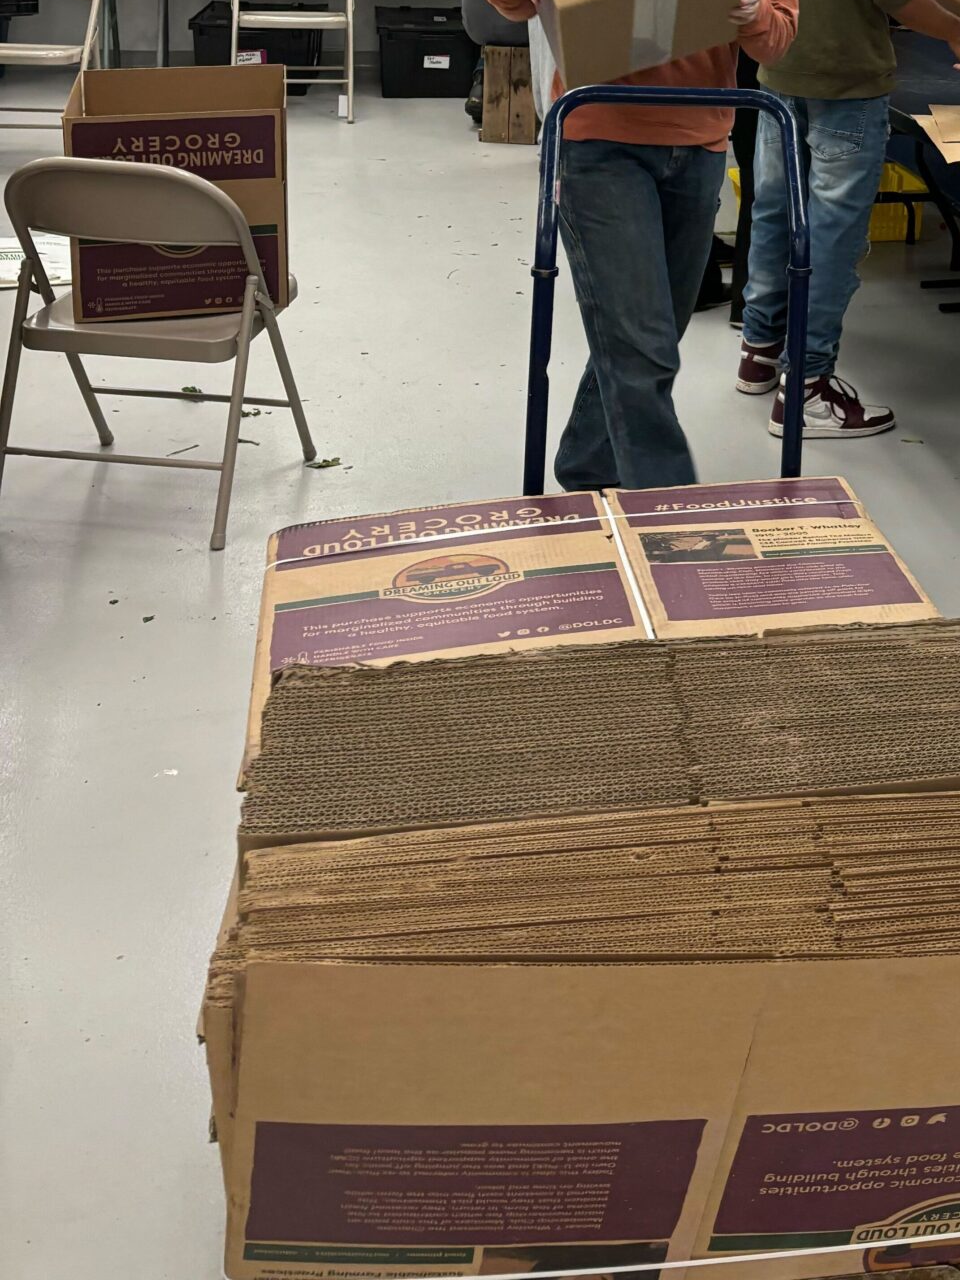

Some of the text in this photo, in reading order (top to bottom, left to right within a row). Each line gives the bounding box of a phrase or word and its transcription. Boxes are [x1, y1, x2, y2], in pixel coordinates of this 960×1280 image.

[112, 132, 241, 153] GROCERY
[178, 148, 263, 167] DREAMING
[654, 495, 818, 512] #FoodJustice
[342, 507, 543, 541] GROCERY
[303, 538, 376, 557] LOUD
[383, 571, 521, 596] DREAMING OUT LOUD
[423, 585, 483, 596] GROCERY
[302, 594, 604, 638] for marginalized communities through building
[303, 588, 603, 632] This purchase supports economic opportunities
[360, 606, 564, 636] healthy, equitable food system.
[558, 618, 623, 630] @DOLDC
[760, 1117, 860, 1133] @DOLDC
[832, 1154, 901, 1168] system.
[906, 1152, 948, 1164] food
[763, 1172, 840, 1183] building
[845, 1167, 917, 1180] through
[759, 1181, 885, 1196] opportunities
[857, 1227, 909, 1241] LOUD
[911, 1224, 951, 1237] OUT
